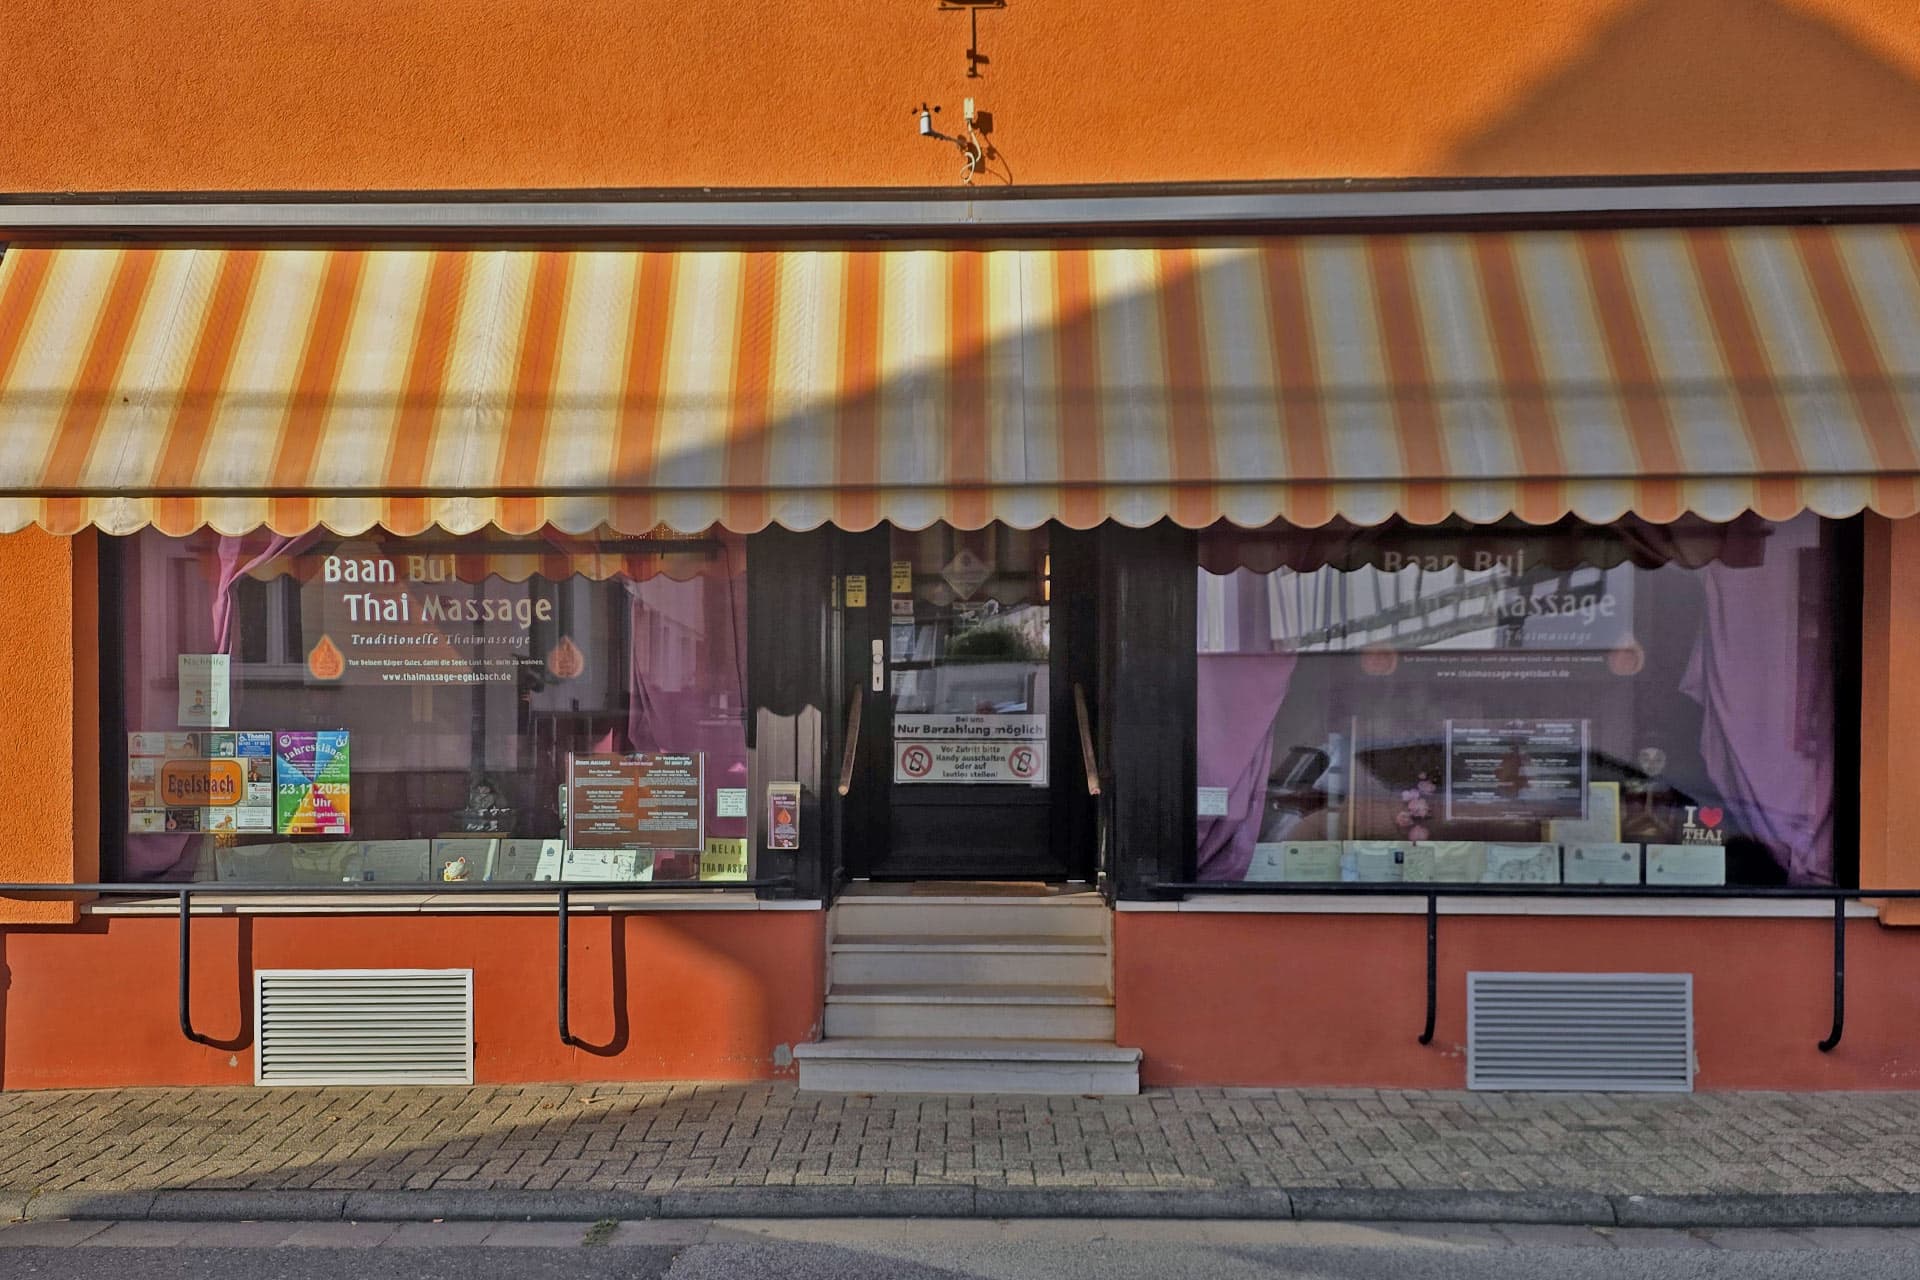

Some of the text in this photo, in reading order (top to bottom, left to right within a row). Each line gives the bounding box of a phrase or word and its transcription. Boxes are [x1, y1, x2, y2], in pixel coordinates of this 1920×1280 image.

[324, 555, 457, 584] Baan Bui
[1384, 549, 1525, 577] Baan Bui
[343, 592, 552, 630] Thai Massage
[1483, 592, 1617, 626] Massage
[351, 632, 531, 649] Traditionelle Thaimassage
[382, 672, 512, 683] www.thaimassage-egelsbach.de
[897, 724, 1043, 737] Nur Barzahlung möglich
[283, 743, 347, 761] Jahresklänge
[941, 745, 1000, 753] Vor Zutritt bitte
[936, 754, 1006, 762] Handy ausschalten
[168, 773, 236, 798] Egelsbach
[280, 783, 349, 795] 23.11.2025
[298, 798, 332, 807] 17 Uhr
[1683, 806, 1697, 827] I
[1683, 828, 1722, 841] THAI
[711, 844, 742, 855] RELAX
